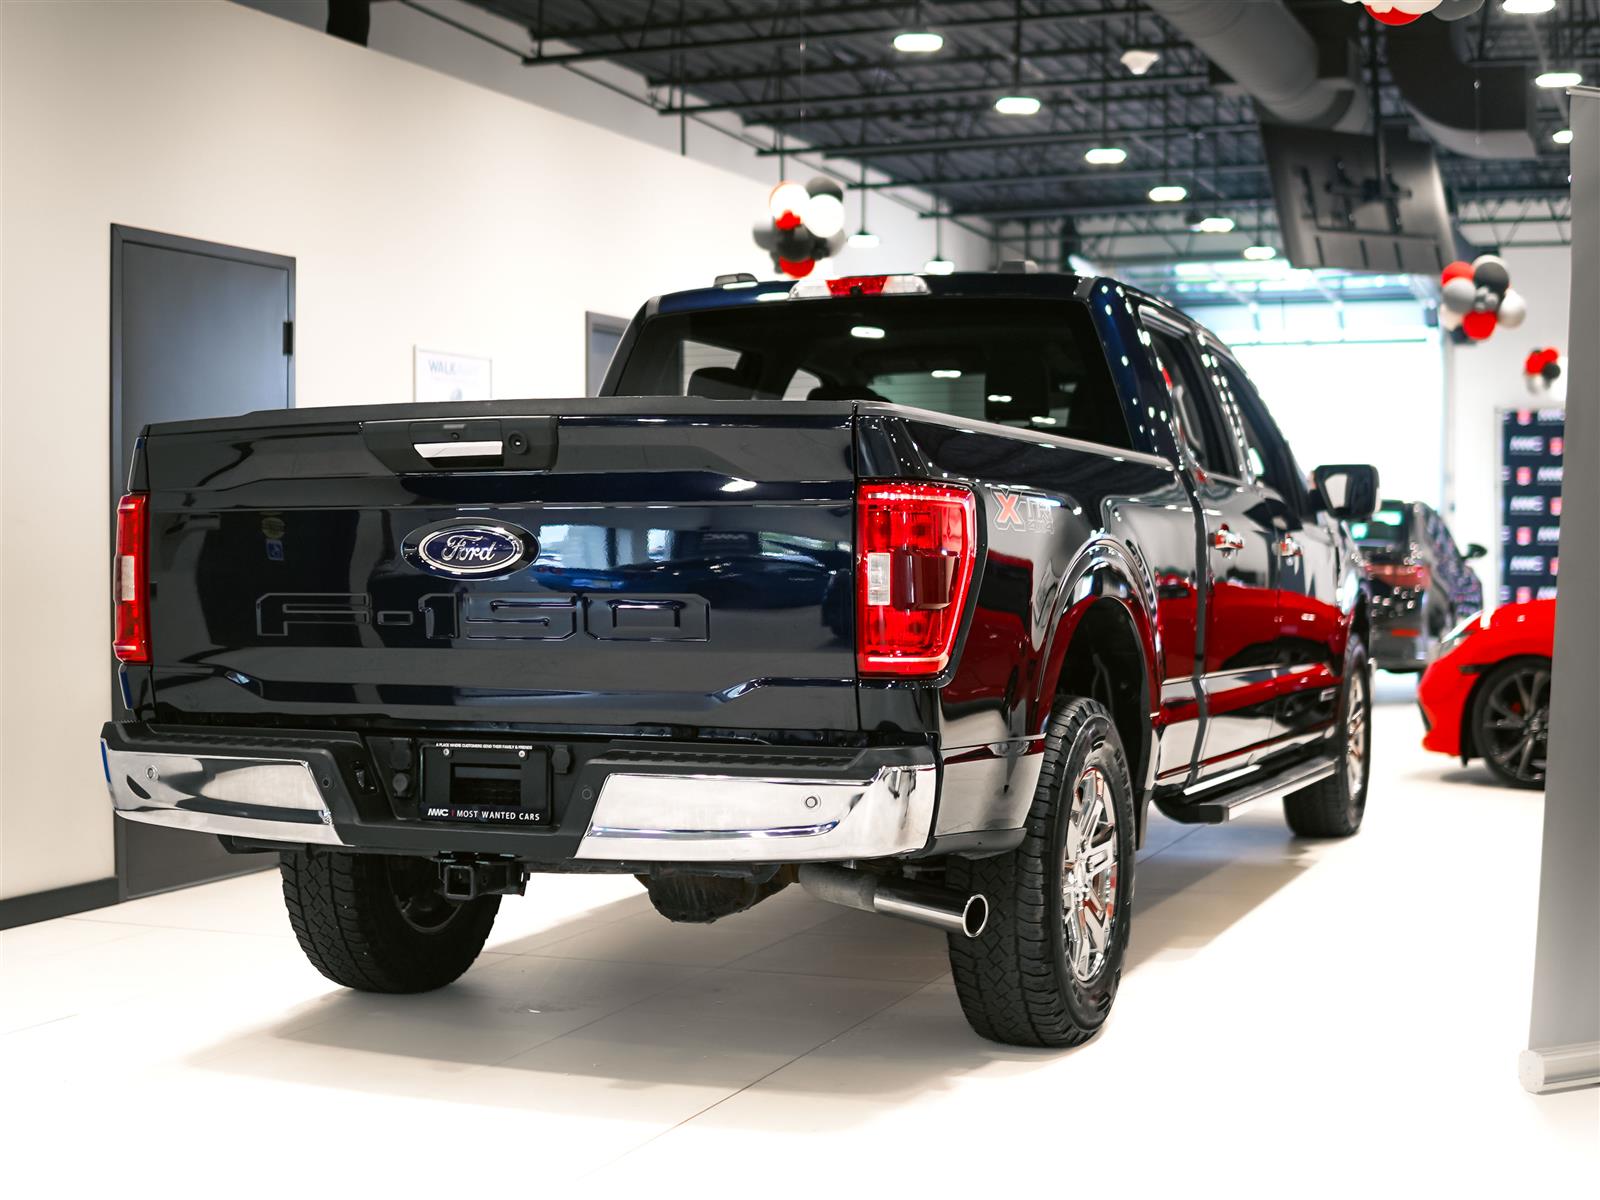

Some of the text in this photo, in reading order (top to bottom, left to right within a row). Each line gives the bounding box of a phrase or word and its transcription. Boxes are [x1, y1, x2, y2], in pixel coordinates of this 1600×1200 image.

[441, 534, 497, 561] Ford
[256, 592, 710, 642] F-150
[427, 808, 540, 821] MWC MOST WANTED CARS
